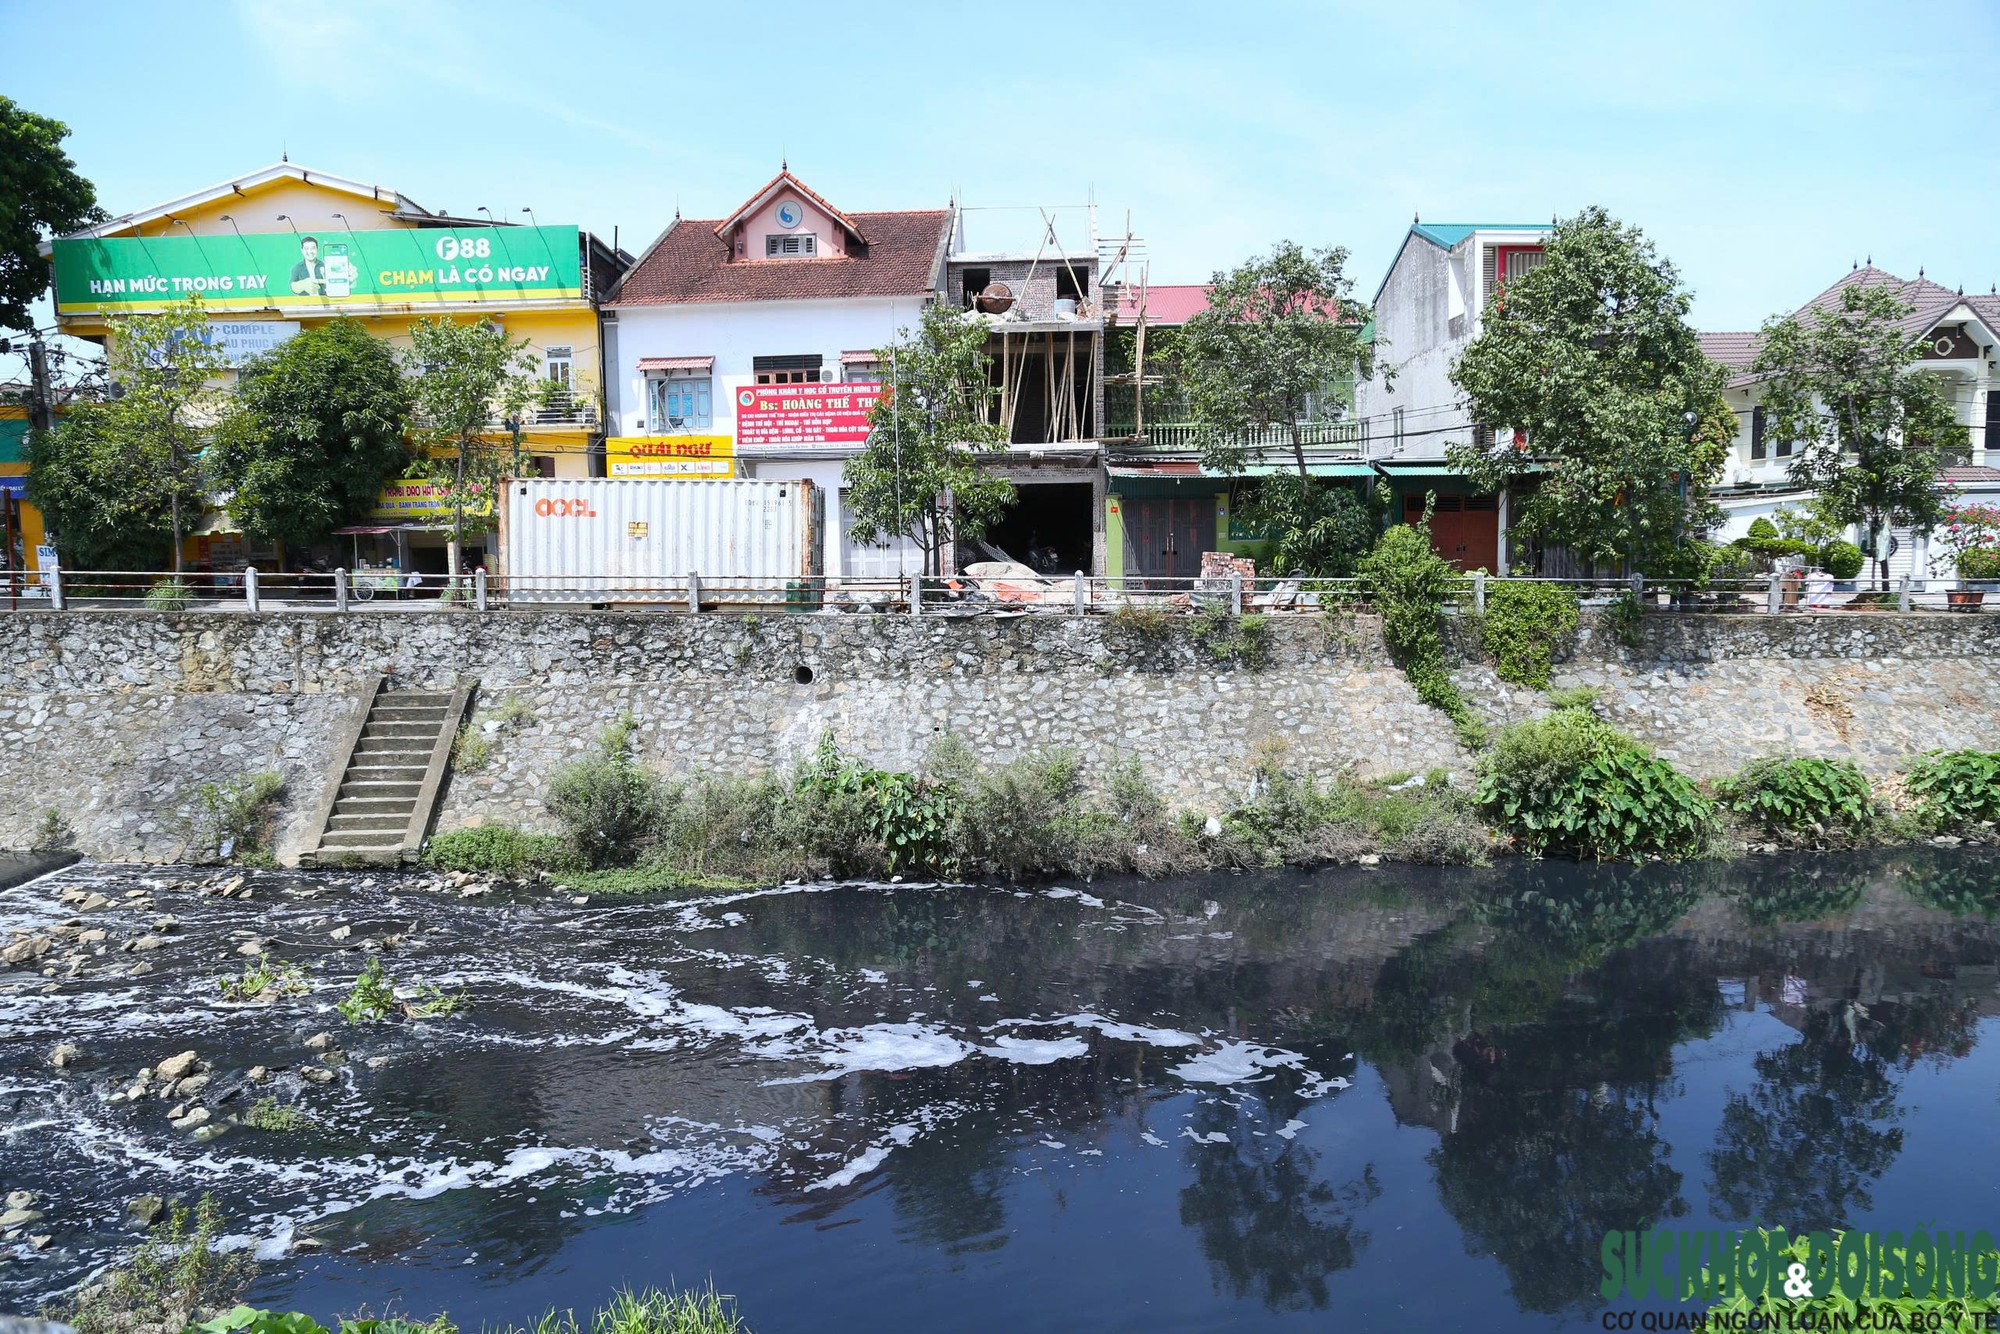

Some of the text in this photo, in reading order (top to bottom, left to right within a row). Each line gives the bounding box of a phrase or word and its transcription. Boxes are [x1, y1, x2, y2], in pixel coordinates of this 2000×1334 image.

[436, 236, 491, 261] F88
[90, 275, 268, 298] HẠN MỨC TRONG TAY
[379, 264, 549, 289] CHẠM LÀ CÓ NGAY
[760, 400, 778, 410] Bs:
[782, 397, 822, 410] HOÀNG
[825, 395, 850, 409] THẾ
[535, 498, 597, 517] OOCL
[39, 547, 56, 557] SIM
